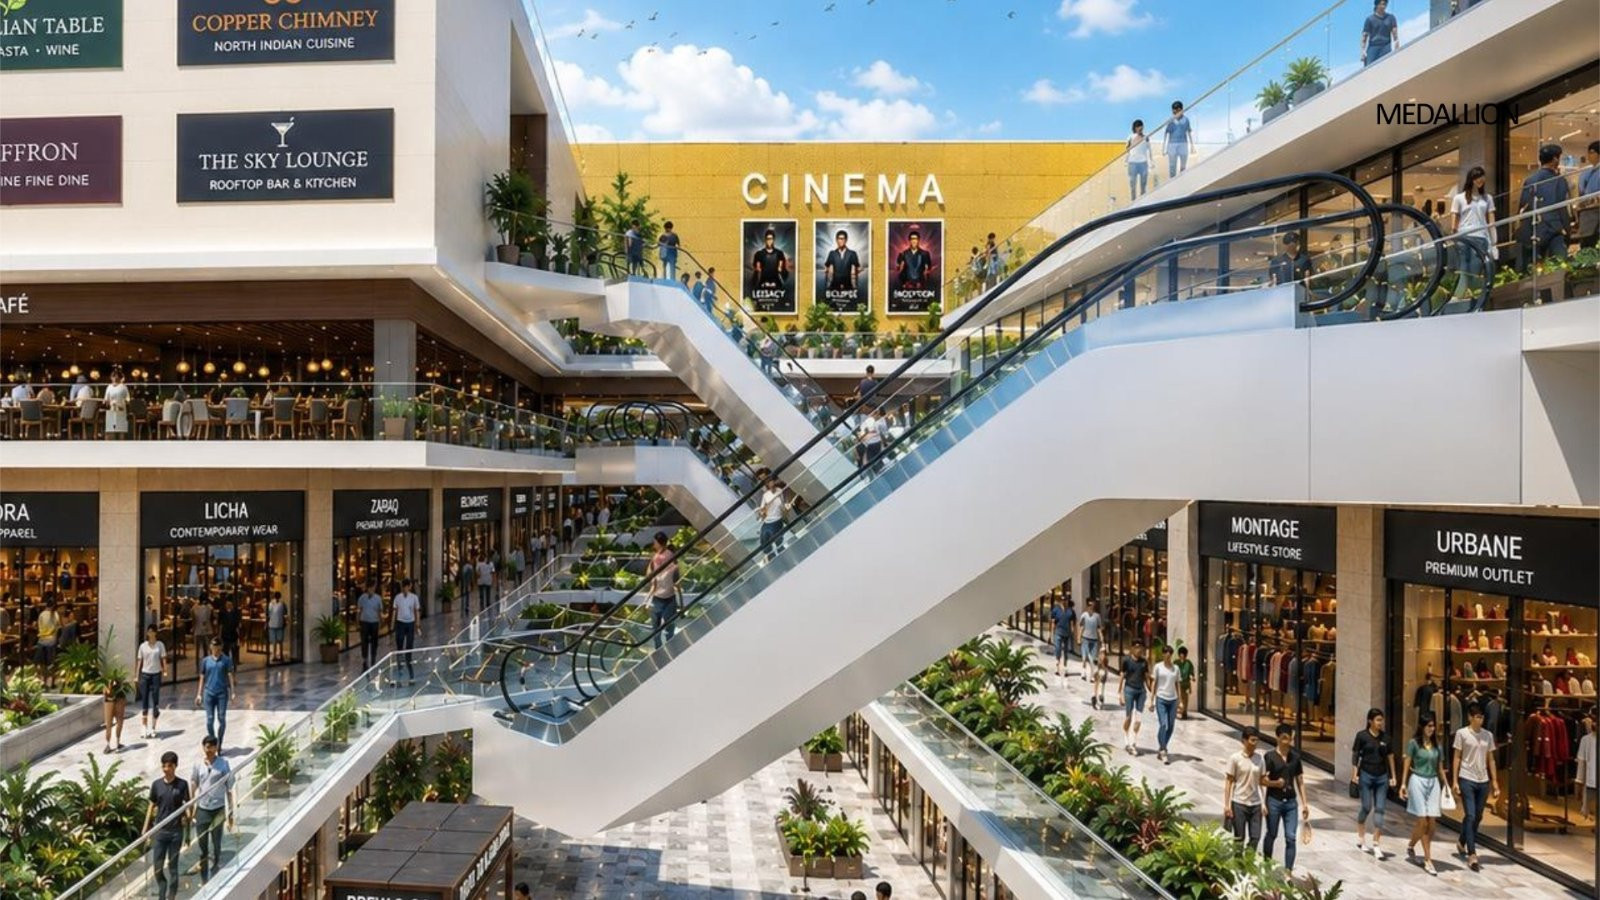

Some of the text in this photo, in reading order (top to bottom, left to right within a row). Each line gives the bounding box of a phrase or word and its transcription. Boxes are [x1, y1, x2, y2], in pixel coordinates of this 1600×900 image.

[0, 16, 104, 35] IAN TABLE
[193, 10, 378, 32] COPPER CHIMNEY
[46, 44, 80, 56] WINE
[214, 37, 355, 52] NORTH INDIAN CUISINE
[199, 151, 368, 170] THE SKY LOUNGE
[25, 175, 54, 186] FINE
[59, 174, 89, 186] DINE
[209, 176, 357, 190] ROOFTOP BAR & KITCHEN
[741, 172, 945, 205] CINEMA
[0, 503, 30, 521] RA
[204, 501, 249, 520] LICHA
[252, 524, 279, 536] WEAR
[1231, 516, 1300, 539] MONTAGE
[1227, 541, 1303, 560] LIFESTYLE STORE
[1437, 530, 1522, 560] URBANE
[1425, 560, 1534, 585] PREMIUM OUTLET
